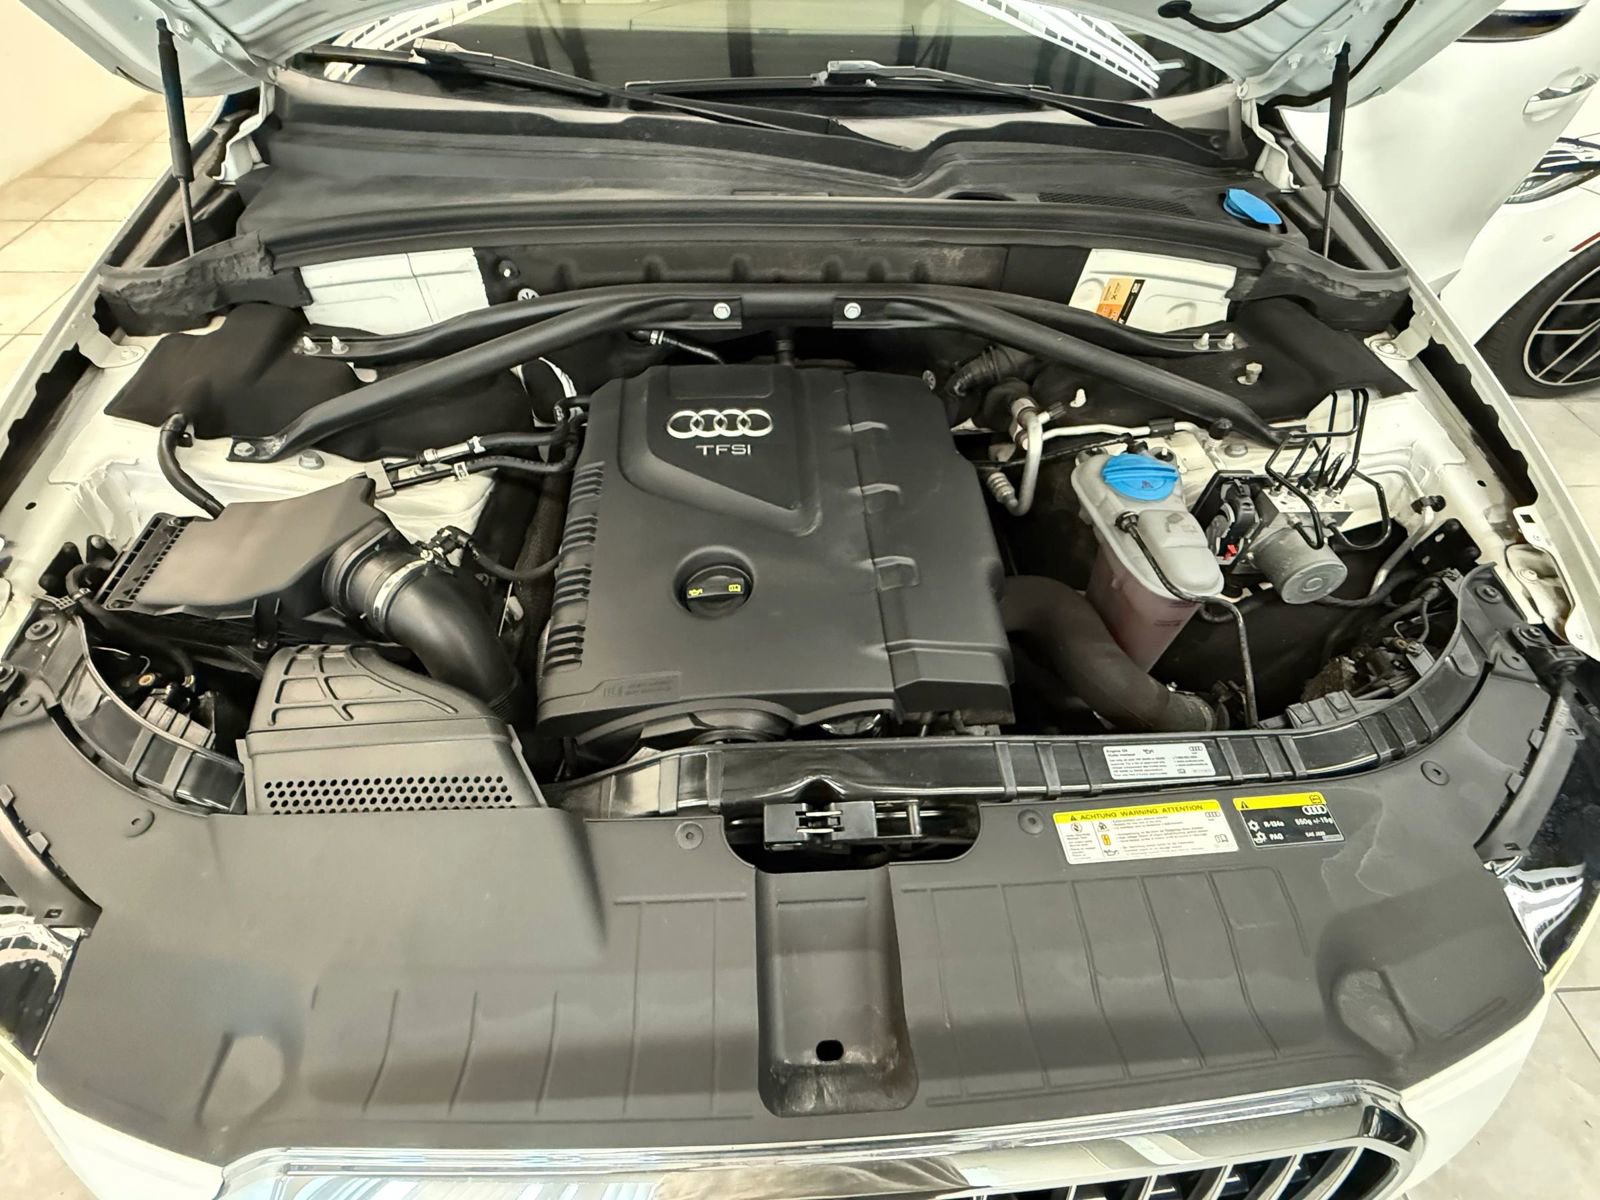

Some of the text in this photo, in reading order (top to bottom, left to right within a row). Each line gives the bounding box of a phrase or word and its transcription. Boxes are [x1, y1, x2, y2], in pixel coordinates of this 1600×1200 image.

[695, 444, 751, 456] TFSI
[1080, 804, 1203, 821] ACHTUNG WARNING ATTENTION
